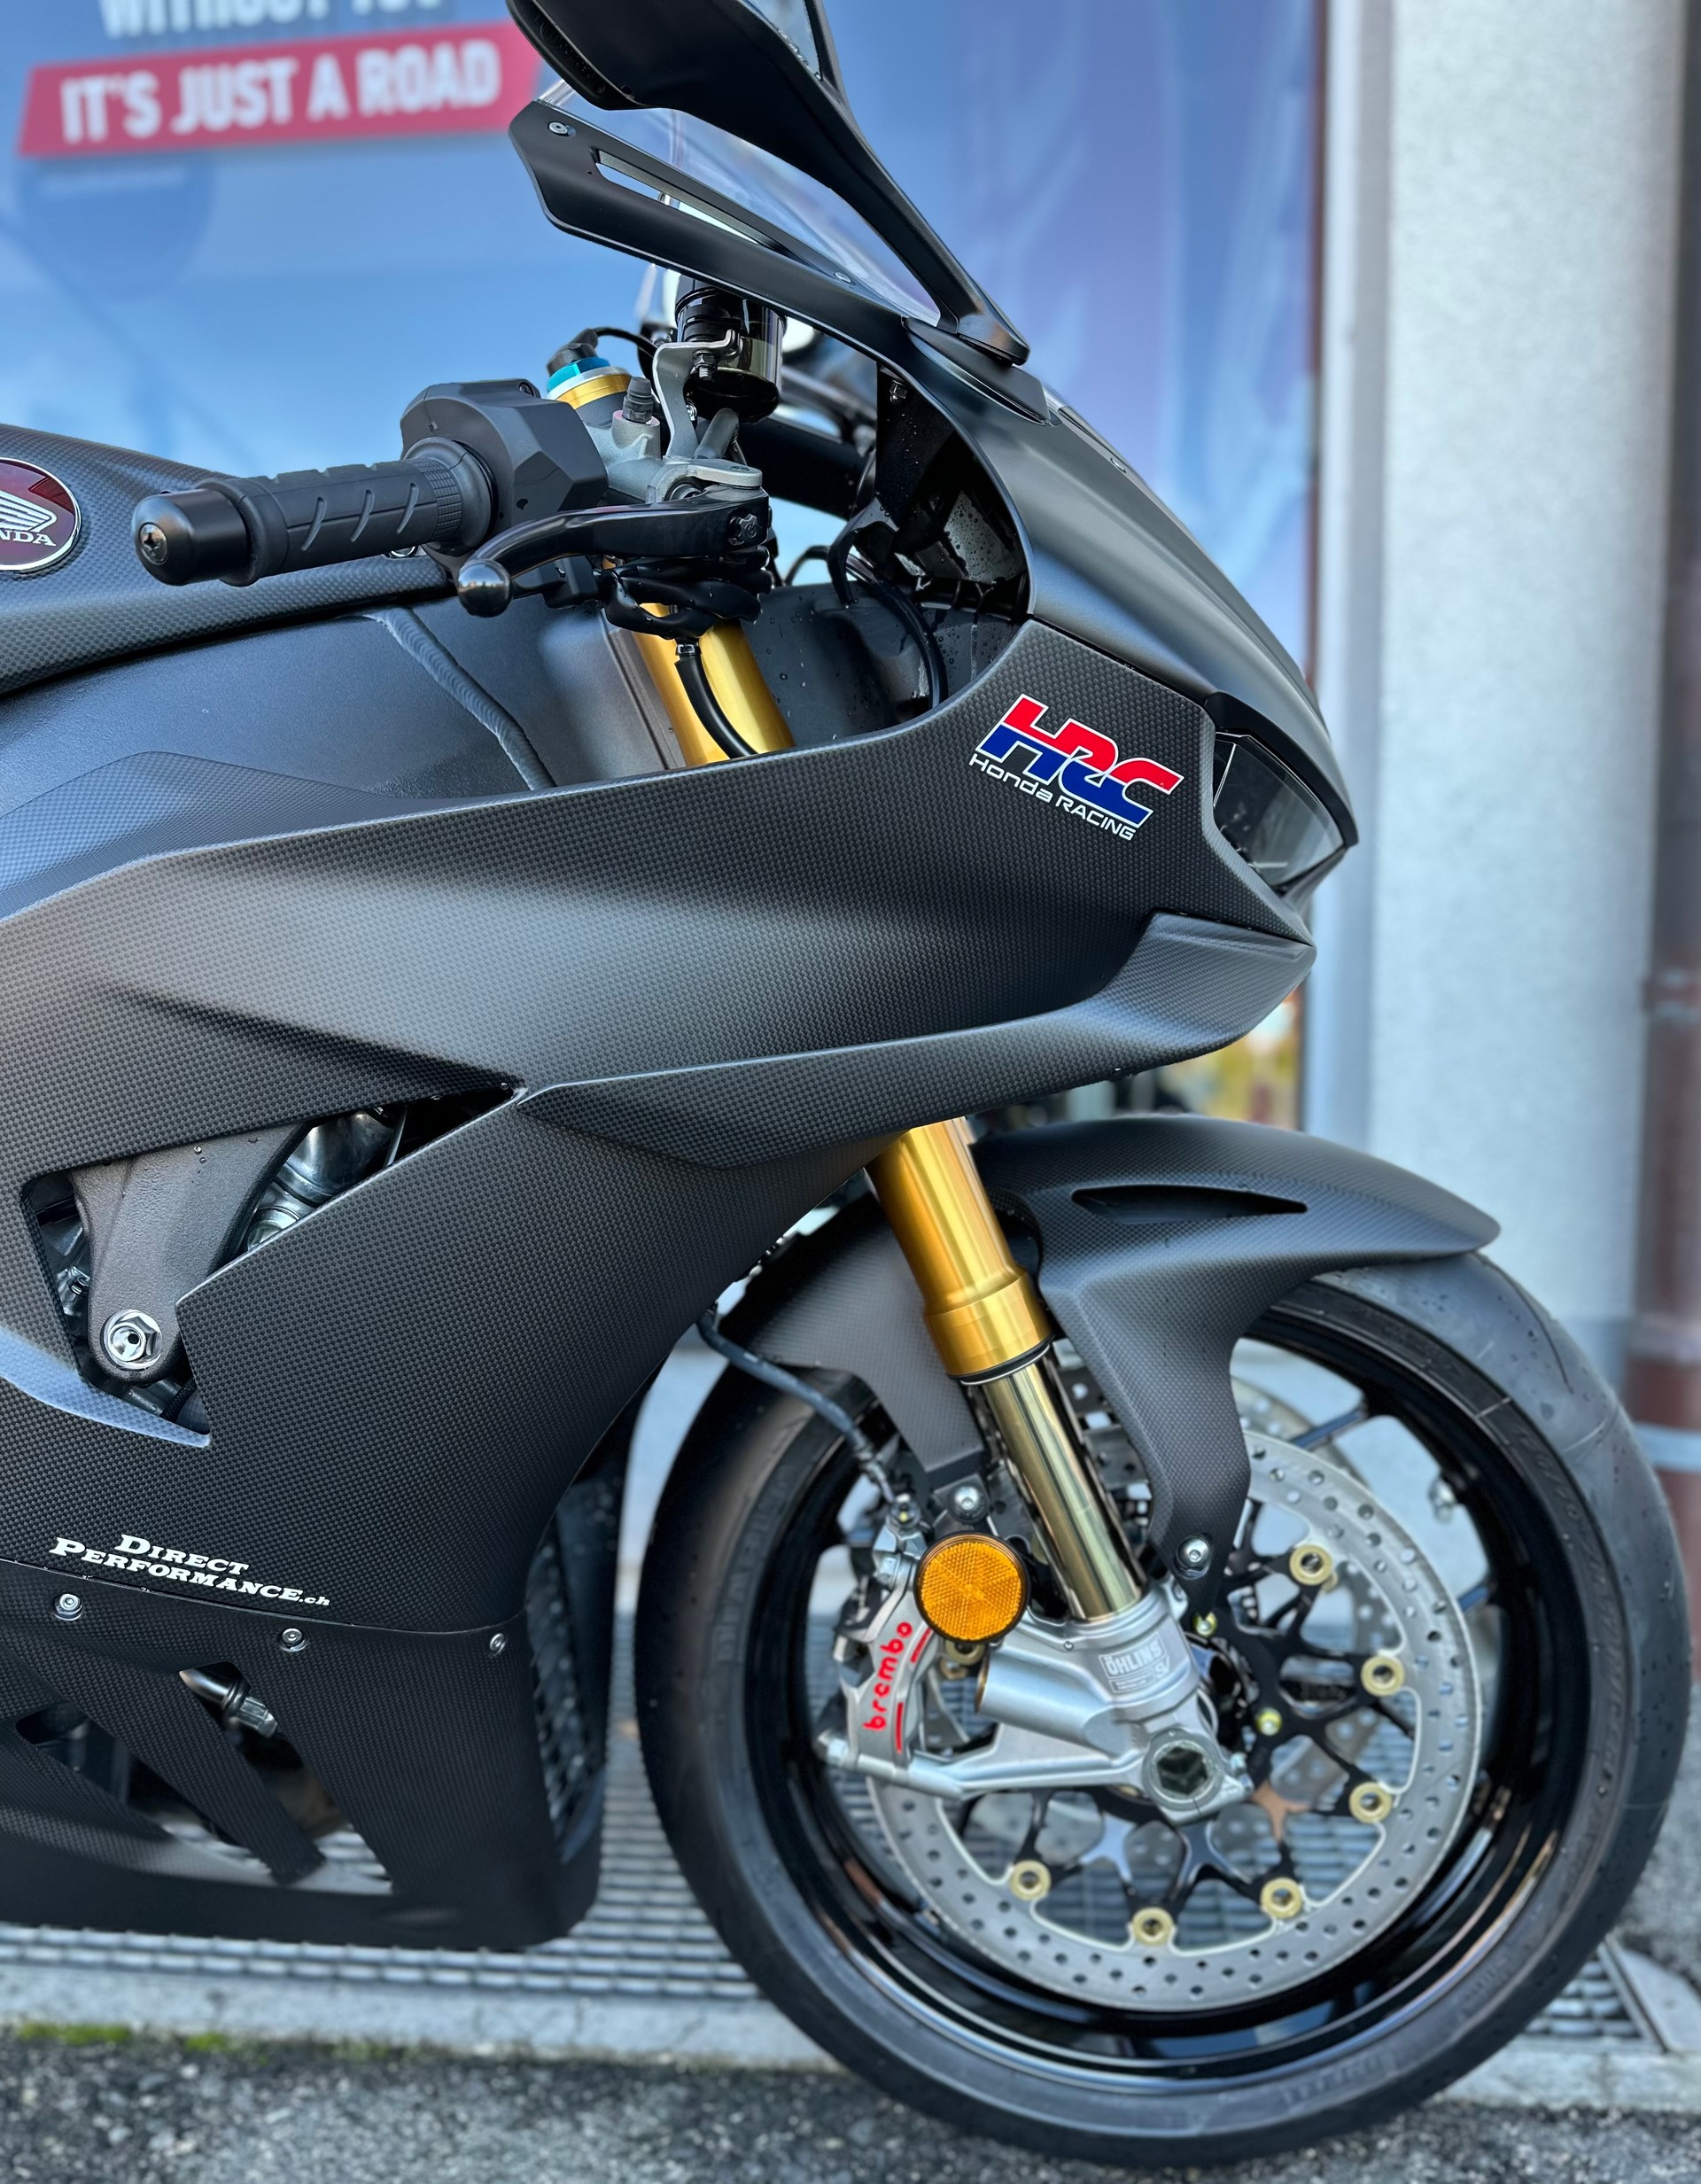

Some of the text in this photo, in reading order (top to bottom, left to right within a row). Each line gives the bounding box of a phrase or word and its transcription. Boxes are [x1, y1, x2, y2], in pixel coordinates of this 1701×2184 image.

[60, 39, 502, 144] IT'S JUST A ROAD
[969, 754, 1136, 841] Honda RACING
[975, 693, 1184, 828] HRC
[114, 1534, 249, 1575] DIRECT
[861, 1621, 913, 1731] brembo
[1104, 1639, 1162, 1675] ÖHLINS
